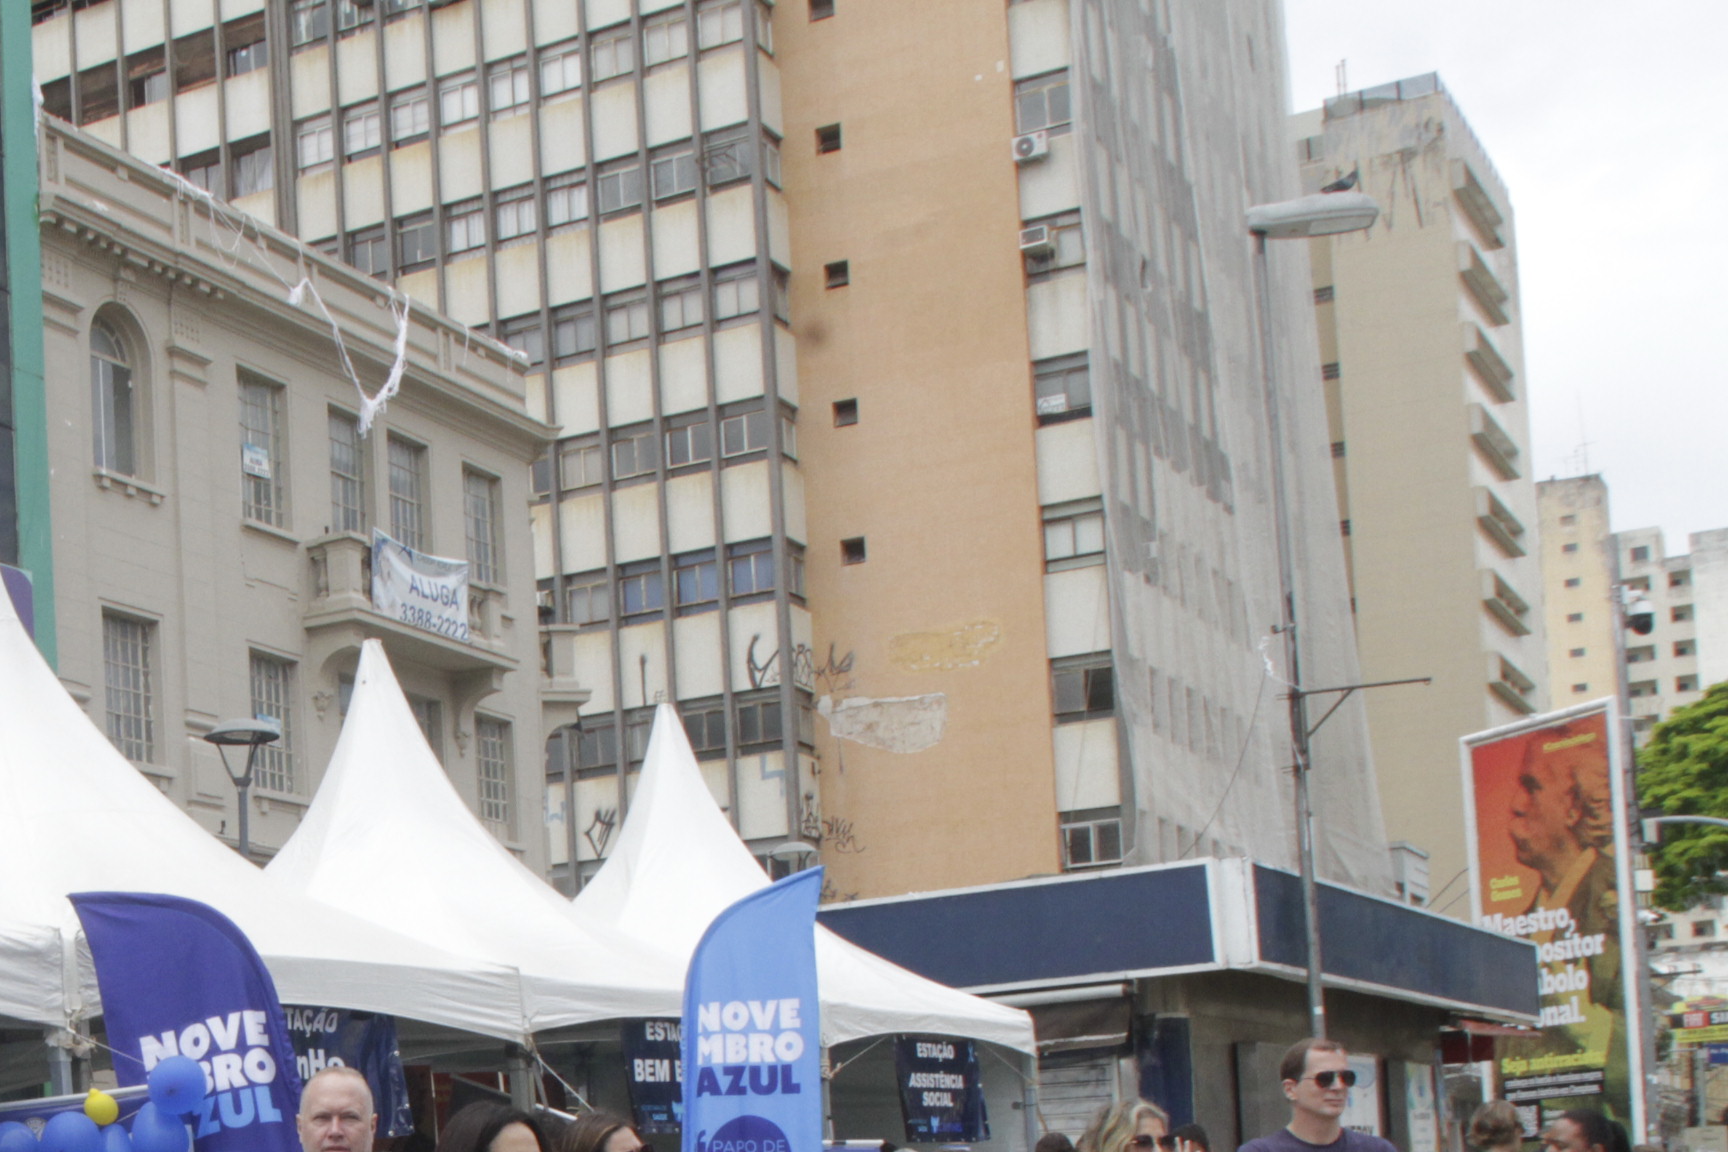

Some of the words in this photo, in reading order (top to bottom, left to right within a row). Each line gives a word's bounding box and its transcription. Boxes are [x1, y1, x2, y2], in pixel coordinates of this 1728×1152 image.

[408, 574, 460, 611] ALUGA
[400, 602, 469, 642] 3388-2222
[285, 1006, 339, 1038] TAÇÃO
[697, 998, 801, 1034] NOVE
[139, 1010, 270, 1073] NOVE
[697, 1030, 805, 1066] MBRO
[916, 1041, 955, 1062] ESTAÇÃO
[633, 1058, 671, 1082] BEM
[696, 1064, 801, 1098] AZUL
[909, 1070, 964, 1089] ASSISTÊNCIA
[922, 1091, 954, 1107] SOCIAL
